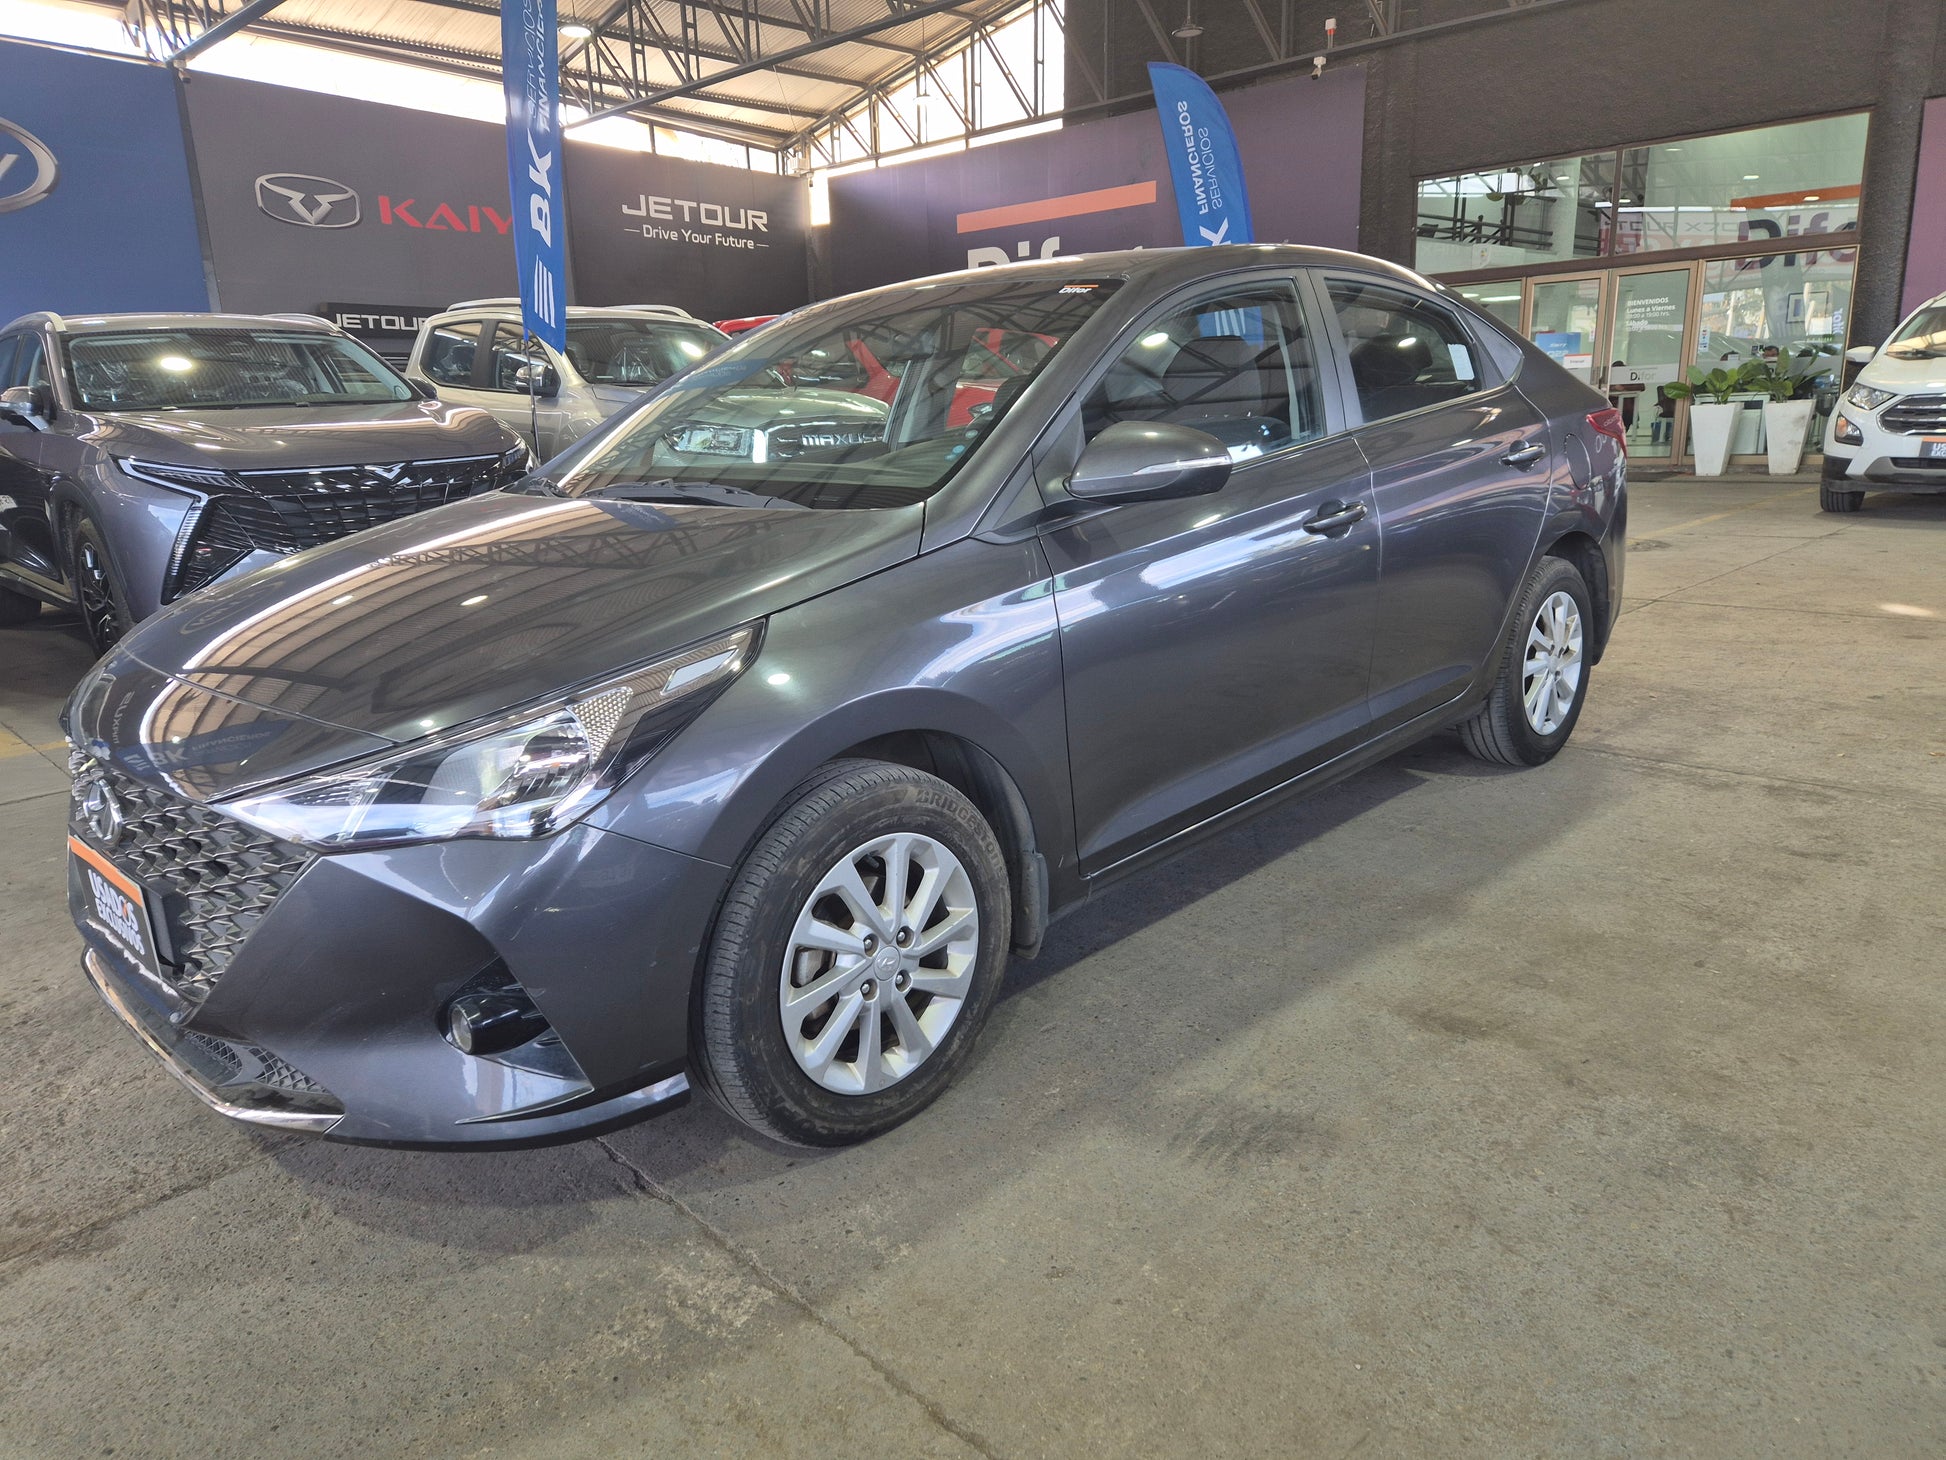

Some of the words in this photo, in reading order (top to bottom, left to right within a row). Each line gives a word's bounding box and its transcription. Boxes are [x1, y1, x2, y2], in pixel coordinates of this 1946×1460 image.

[526, 127, 552, 248] BK
[621, 194, 769, 232] JETOUR
[642, 224, 679, 241] Drive
[682, 229, 712, 245] Your
[715, 233, 755, 249] Future
[1627, 297, 1669, 306] BIENVENIDOS
[1651, 304, 1676, 312] Viernes
[88, 868, 139, 932] USADOS
